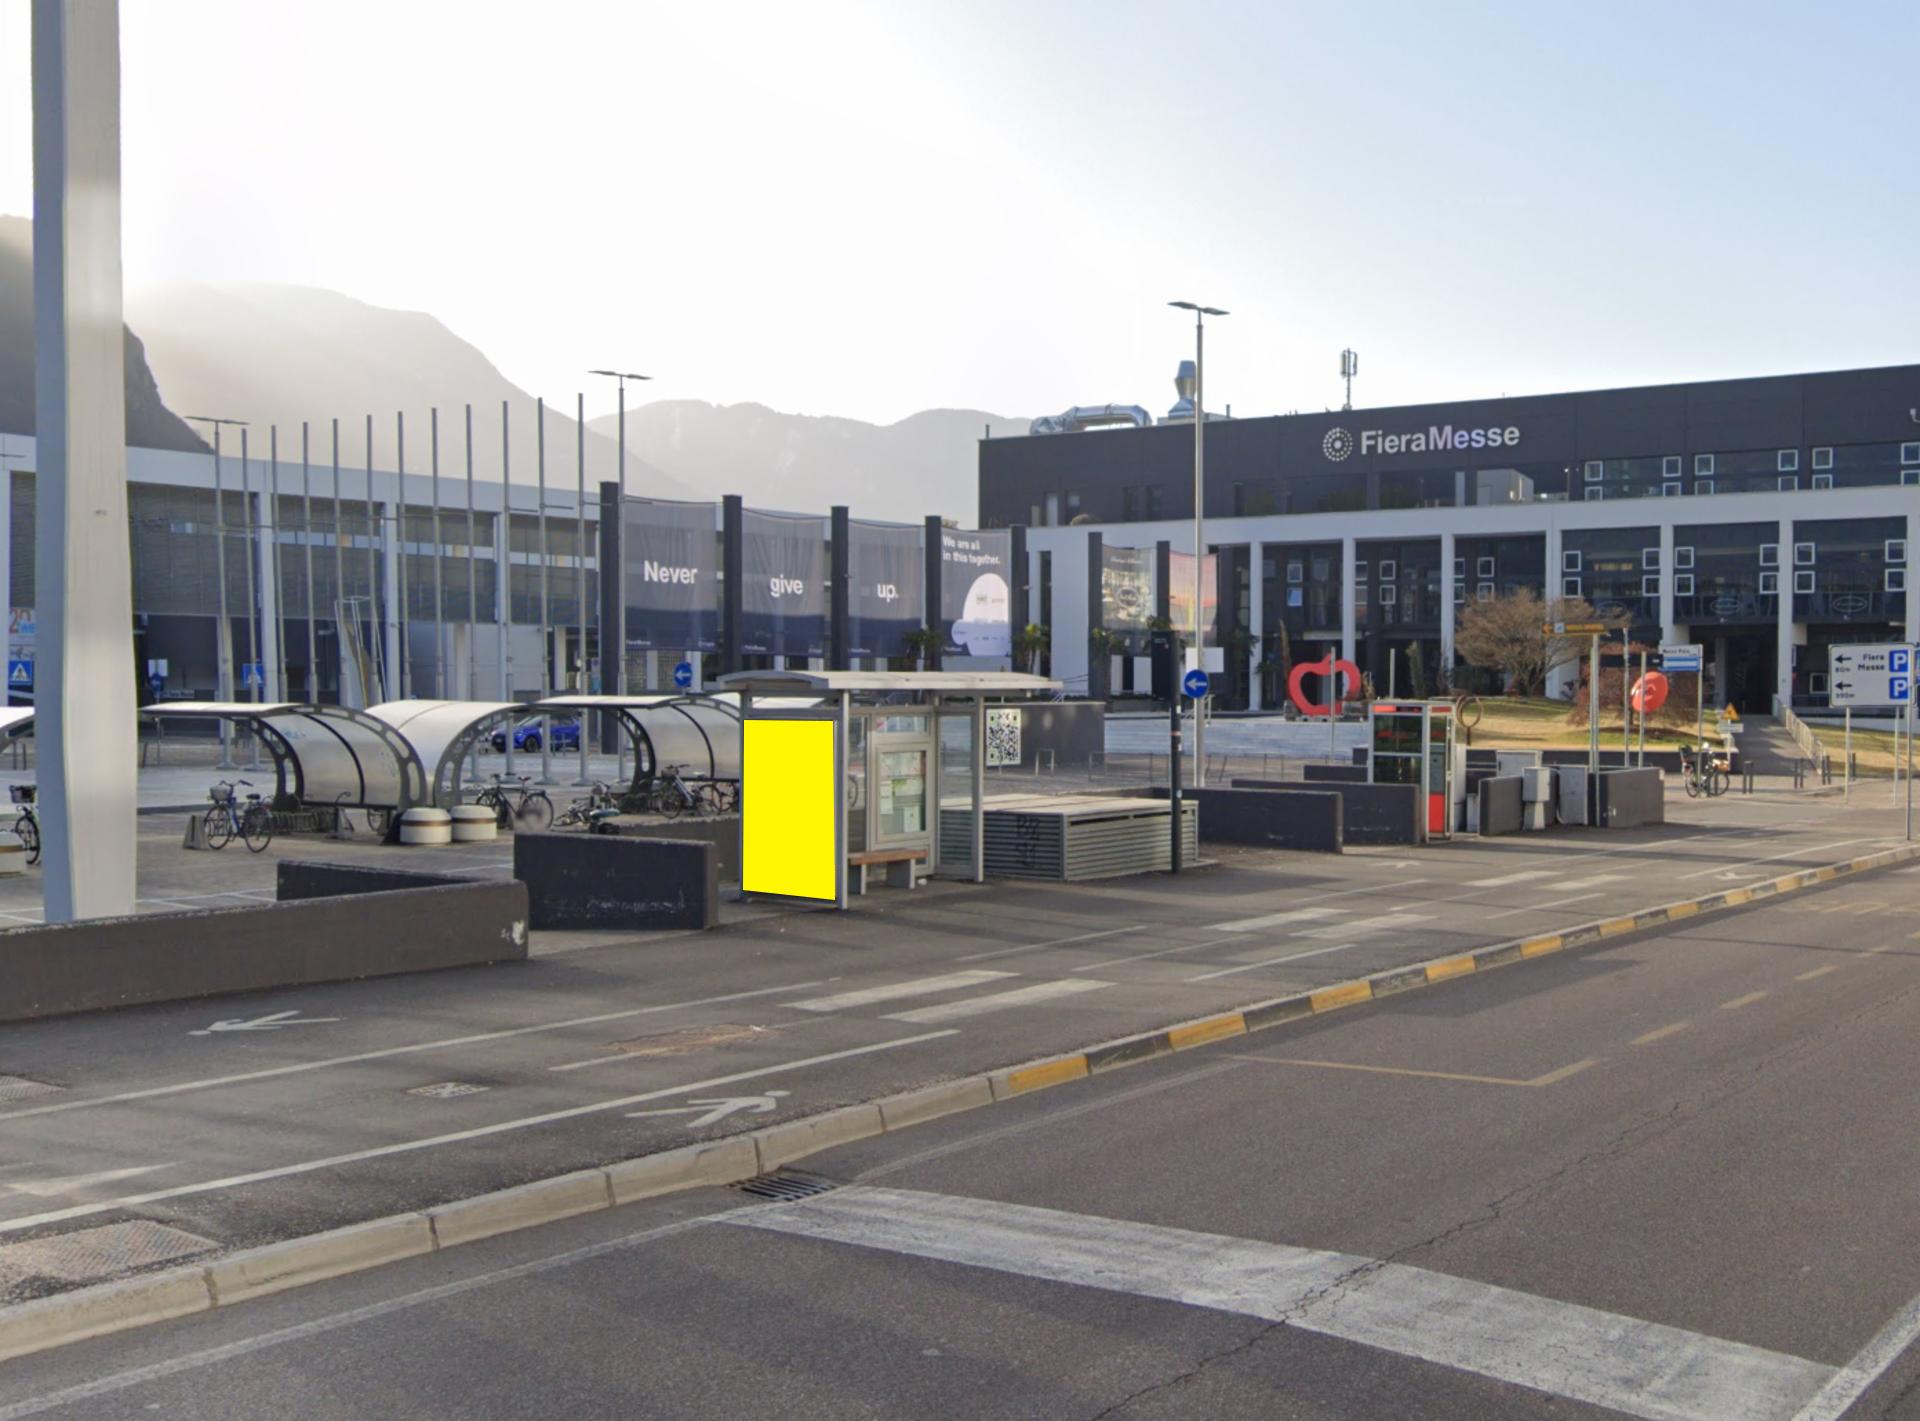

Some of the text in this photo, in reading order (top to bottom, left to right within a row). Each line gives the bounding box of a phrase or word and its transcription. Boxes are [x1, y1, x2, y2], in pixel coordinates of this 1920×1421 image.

[1360, 425, 1520, 455] FieraMesse
[942, 535, 956, 548] We
[957, 539, 970, 549] are
[942, 550, 952, 561] in
[952, 552, 968, 563] this
[643, 560, 698, 584] Never
[769, 574, 804, 598] give
[876, 582, 900, 602] up.
